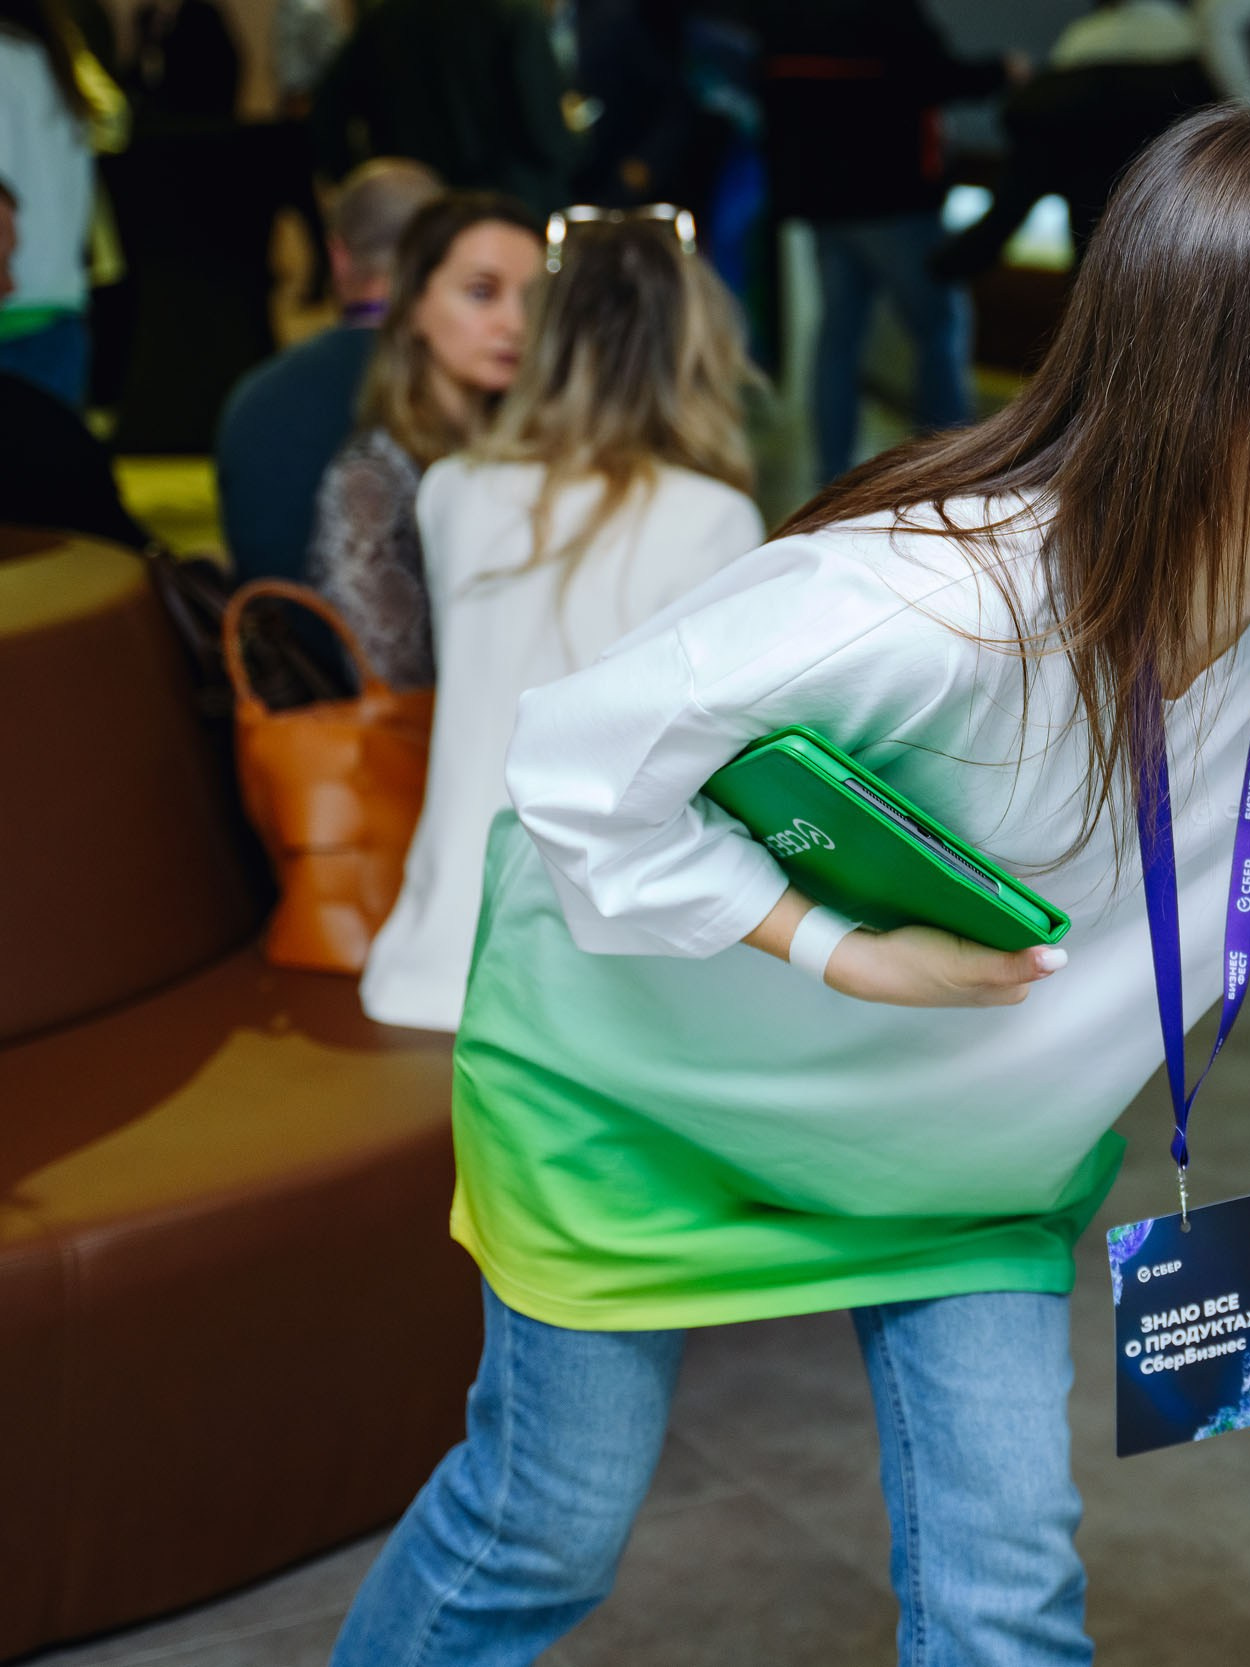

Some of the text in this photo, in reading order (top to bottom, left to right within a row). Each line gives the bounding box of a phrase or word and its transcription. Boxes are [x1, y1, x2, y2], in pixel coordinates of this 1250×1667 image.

[1227, 951, 1239, 1000] БИЗНЕС
[1237, 951, 1248, 985] ФЕСТ
[1152, 1260, 1182, 1278] СБЕР
[1140, 1293, 1240, 1334] ЗНАЮ ВСЕ
[1125, 1340, 1142, 1358] О
[1140, 1337, 1248, 1375] СберБизнес
